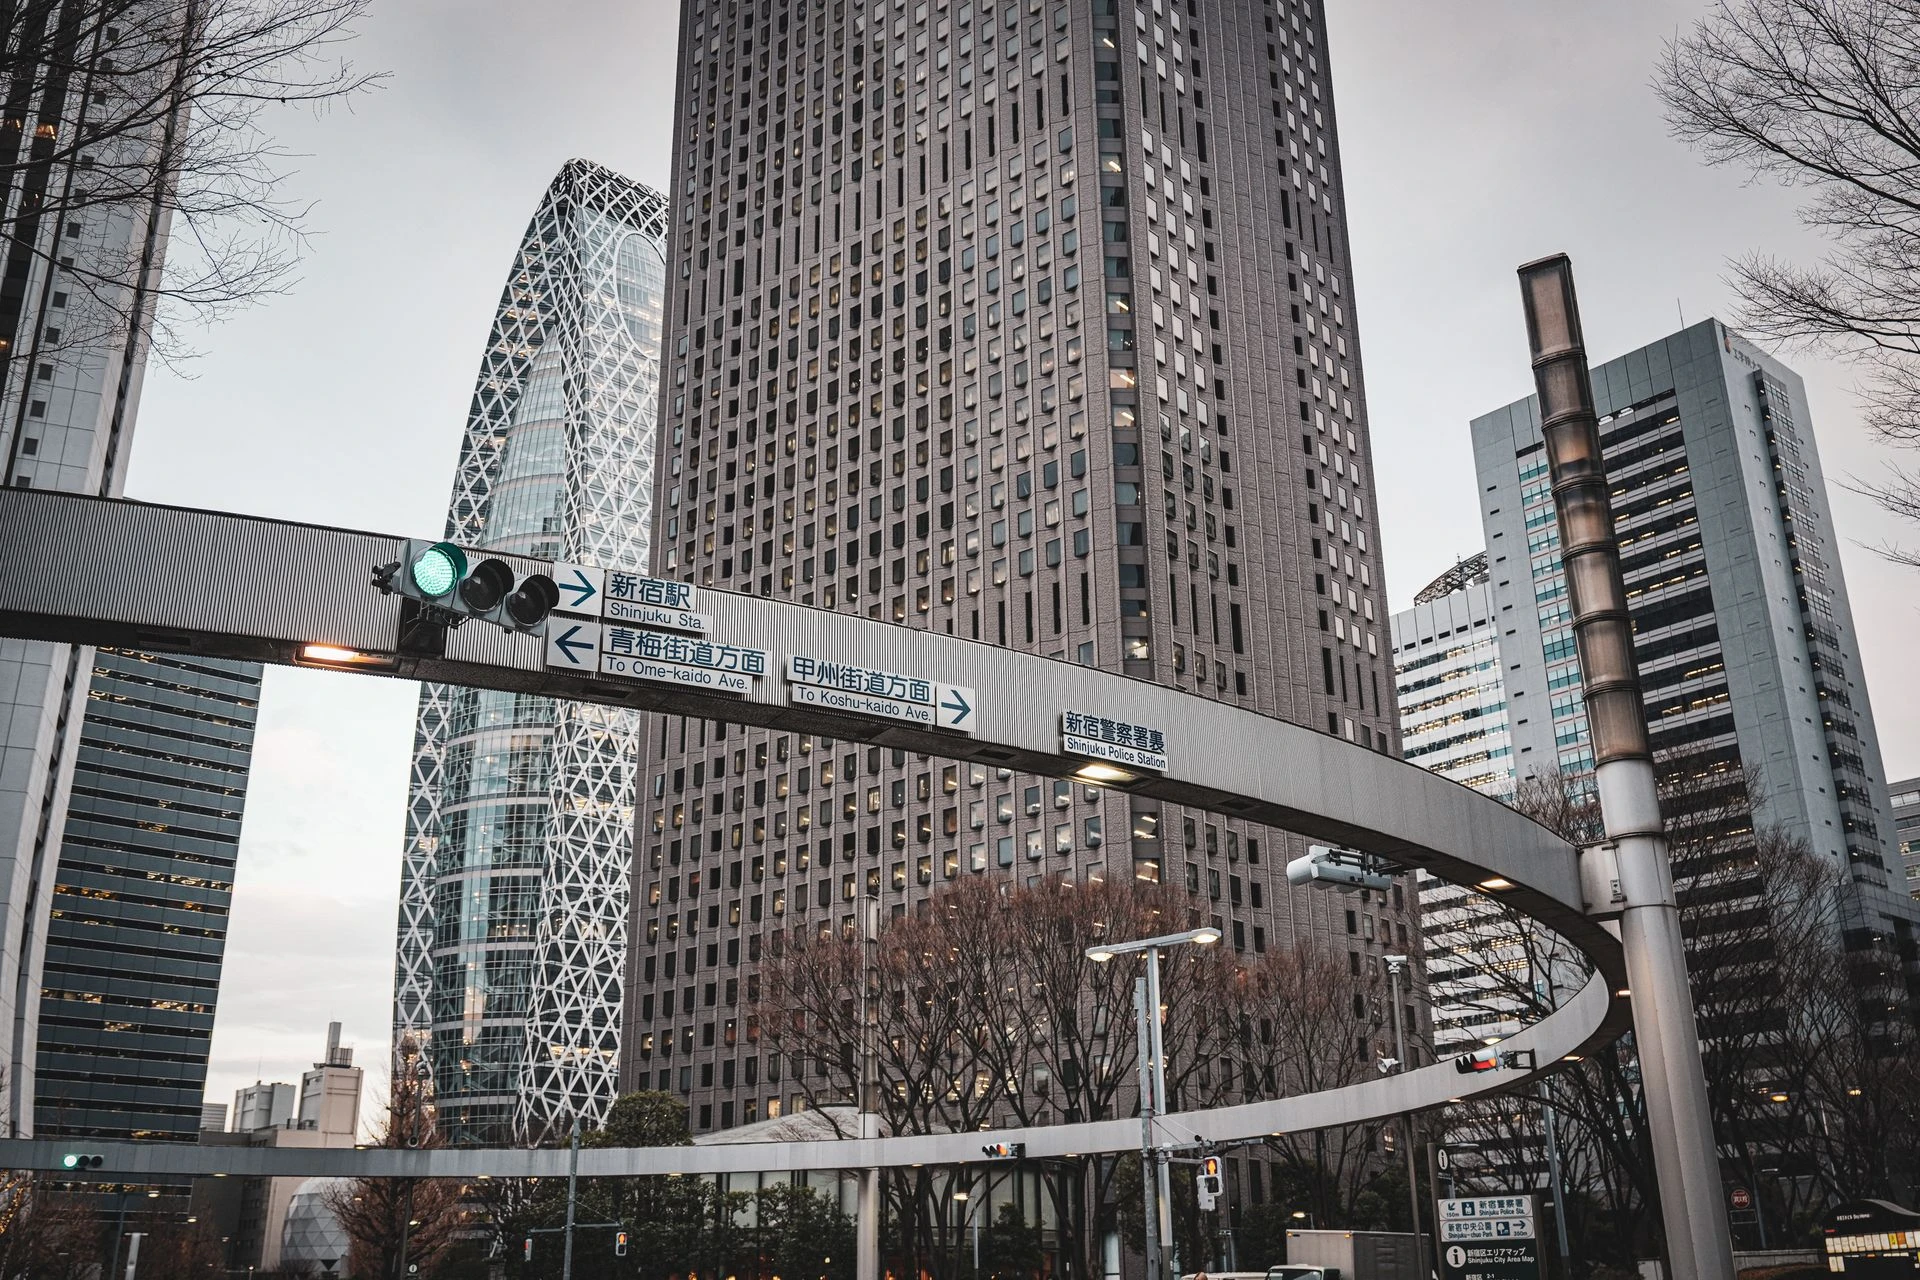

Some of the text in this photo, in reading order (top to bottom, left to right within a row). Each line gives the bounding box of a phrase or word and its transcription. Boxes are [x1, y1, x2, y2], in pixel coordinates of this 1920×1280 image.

[610, 571, 691, 609] 新宿駅
[610, 602, 705, 630] Shinjuku Sta.
[609, 627, 766, 675] 青梅街道方面
[606, 656, 748, 690] To Ome-kaido Ave.
[793, 656, 930, 703] 甲州街道方面
[797, 686, 931, 722] To Koshu-kaido Ave.
[1066, 710, 1165, 753] 新宿警察署裏
[1067, 737, 1166, 769] Shinjuku Police Station
[1479, 1209, 1500, 1217] Shinjuku
[1467, 1257, 1494, 1265] Shinjuku
[1494, 1256, 1506, 1264] City
[1521, 1255, 1535, 1263] Map
